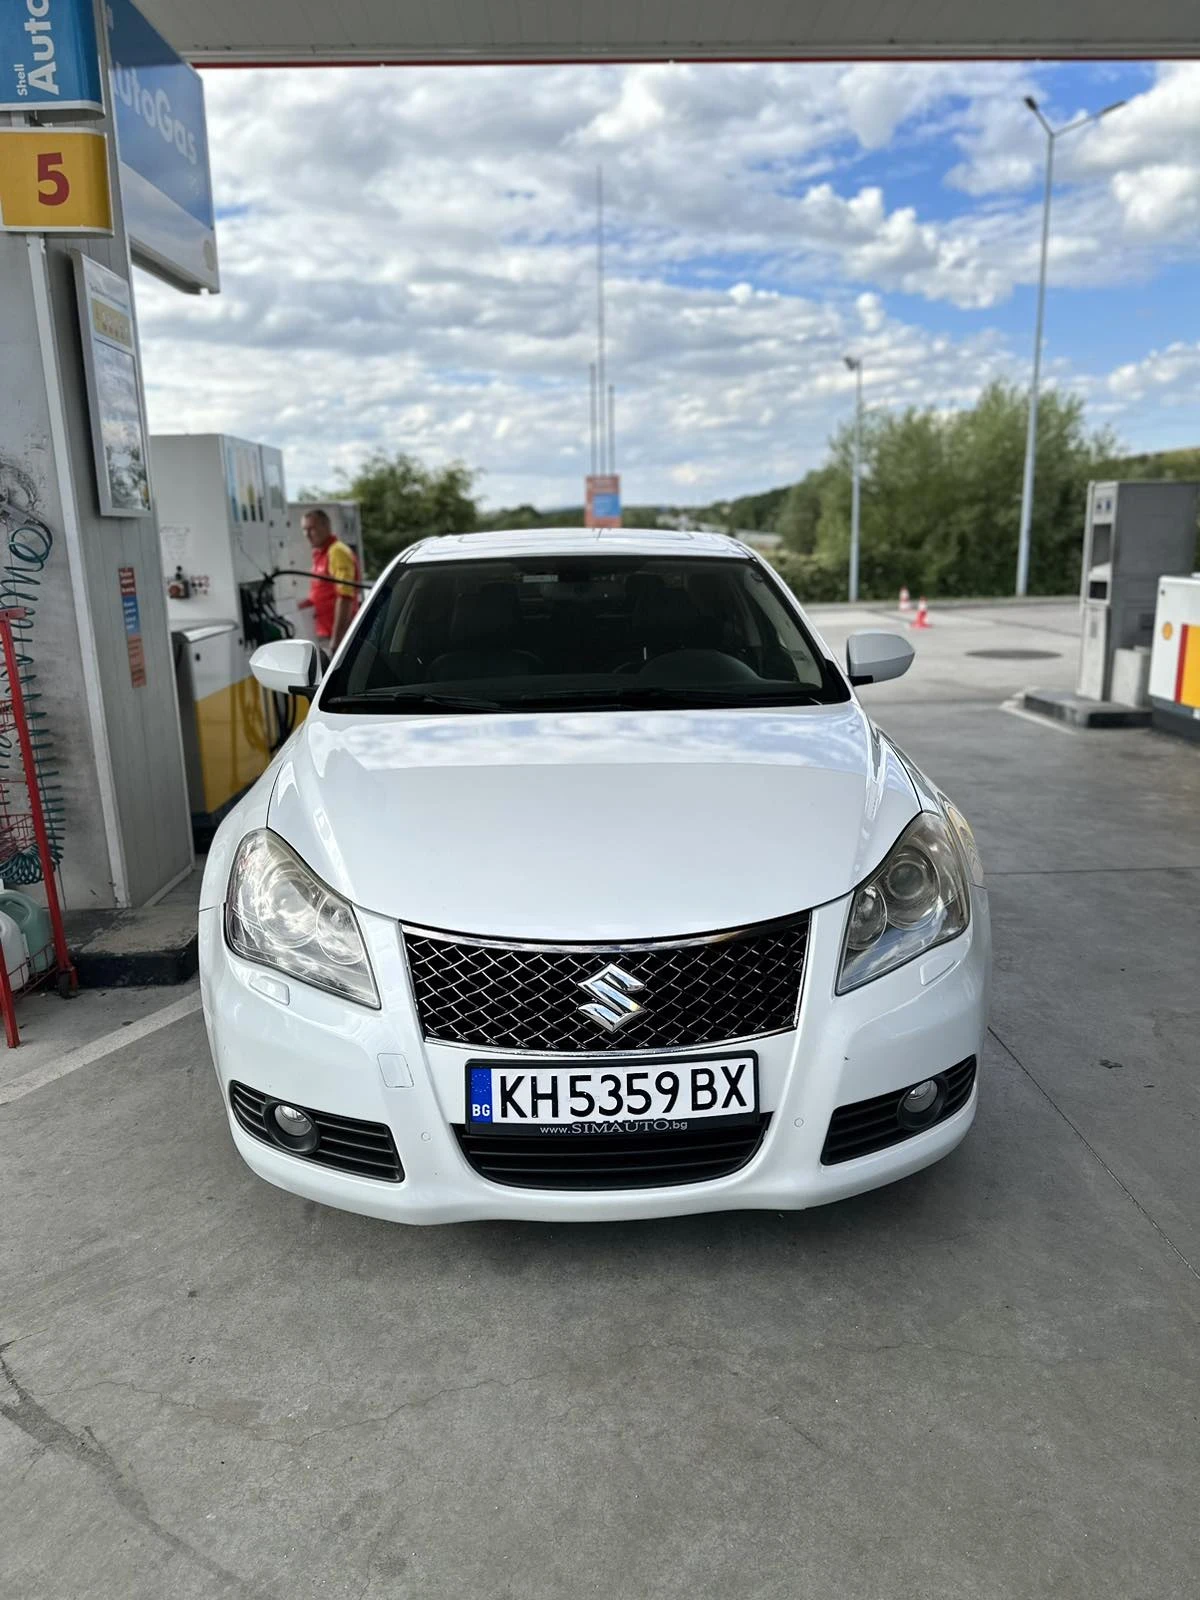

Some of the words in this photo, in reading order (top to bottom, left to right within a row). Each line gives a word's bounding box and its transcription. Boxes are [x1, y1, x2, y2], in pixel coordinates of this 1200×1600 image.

[13, 63, 28, 96] Shell
[37, 152, 70, 206] 5
[500, 1075, 559, 1118] KH
[569, 1070, 680, 1117] 5359
[690, 1064, 747, 1111] BX
[472, 1104, 491, 1117] BG
[540, 1120, 688, 1134] www.SIMAUTO.bg
